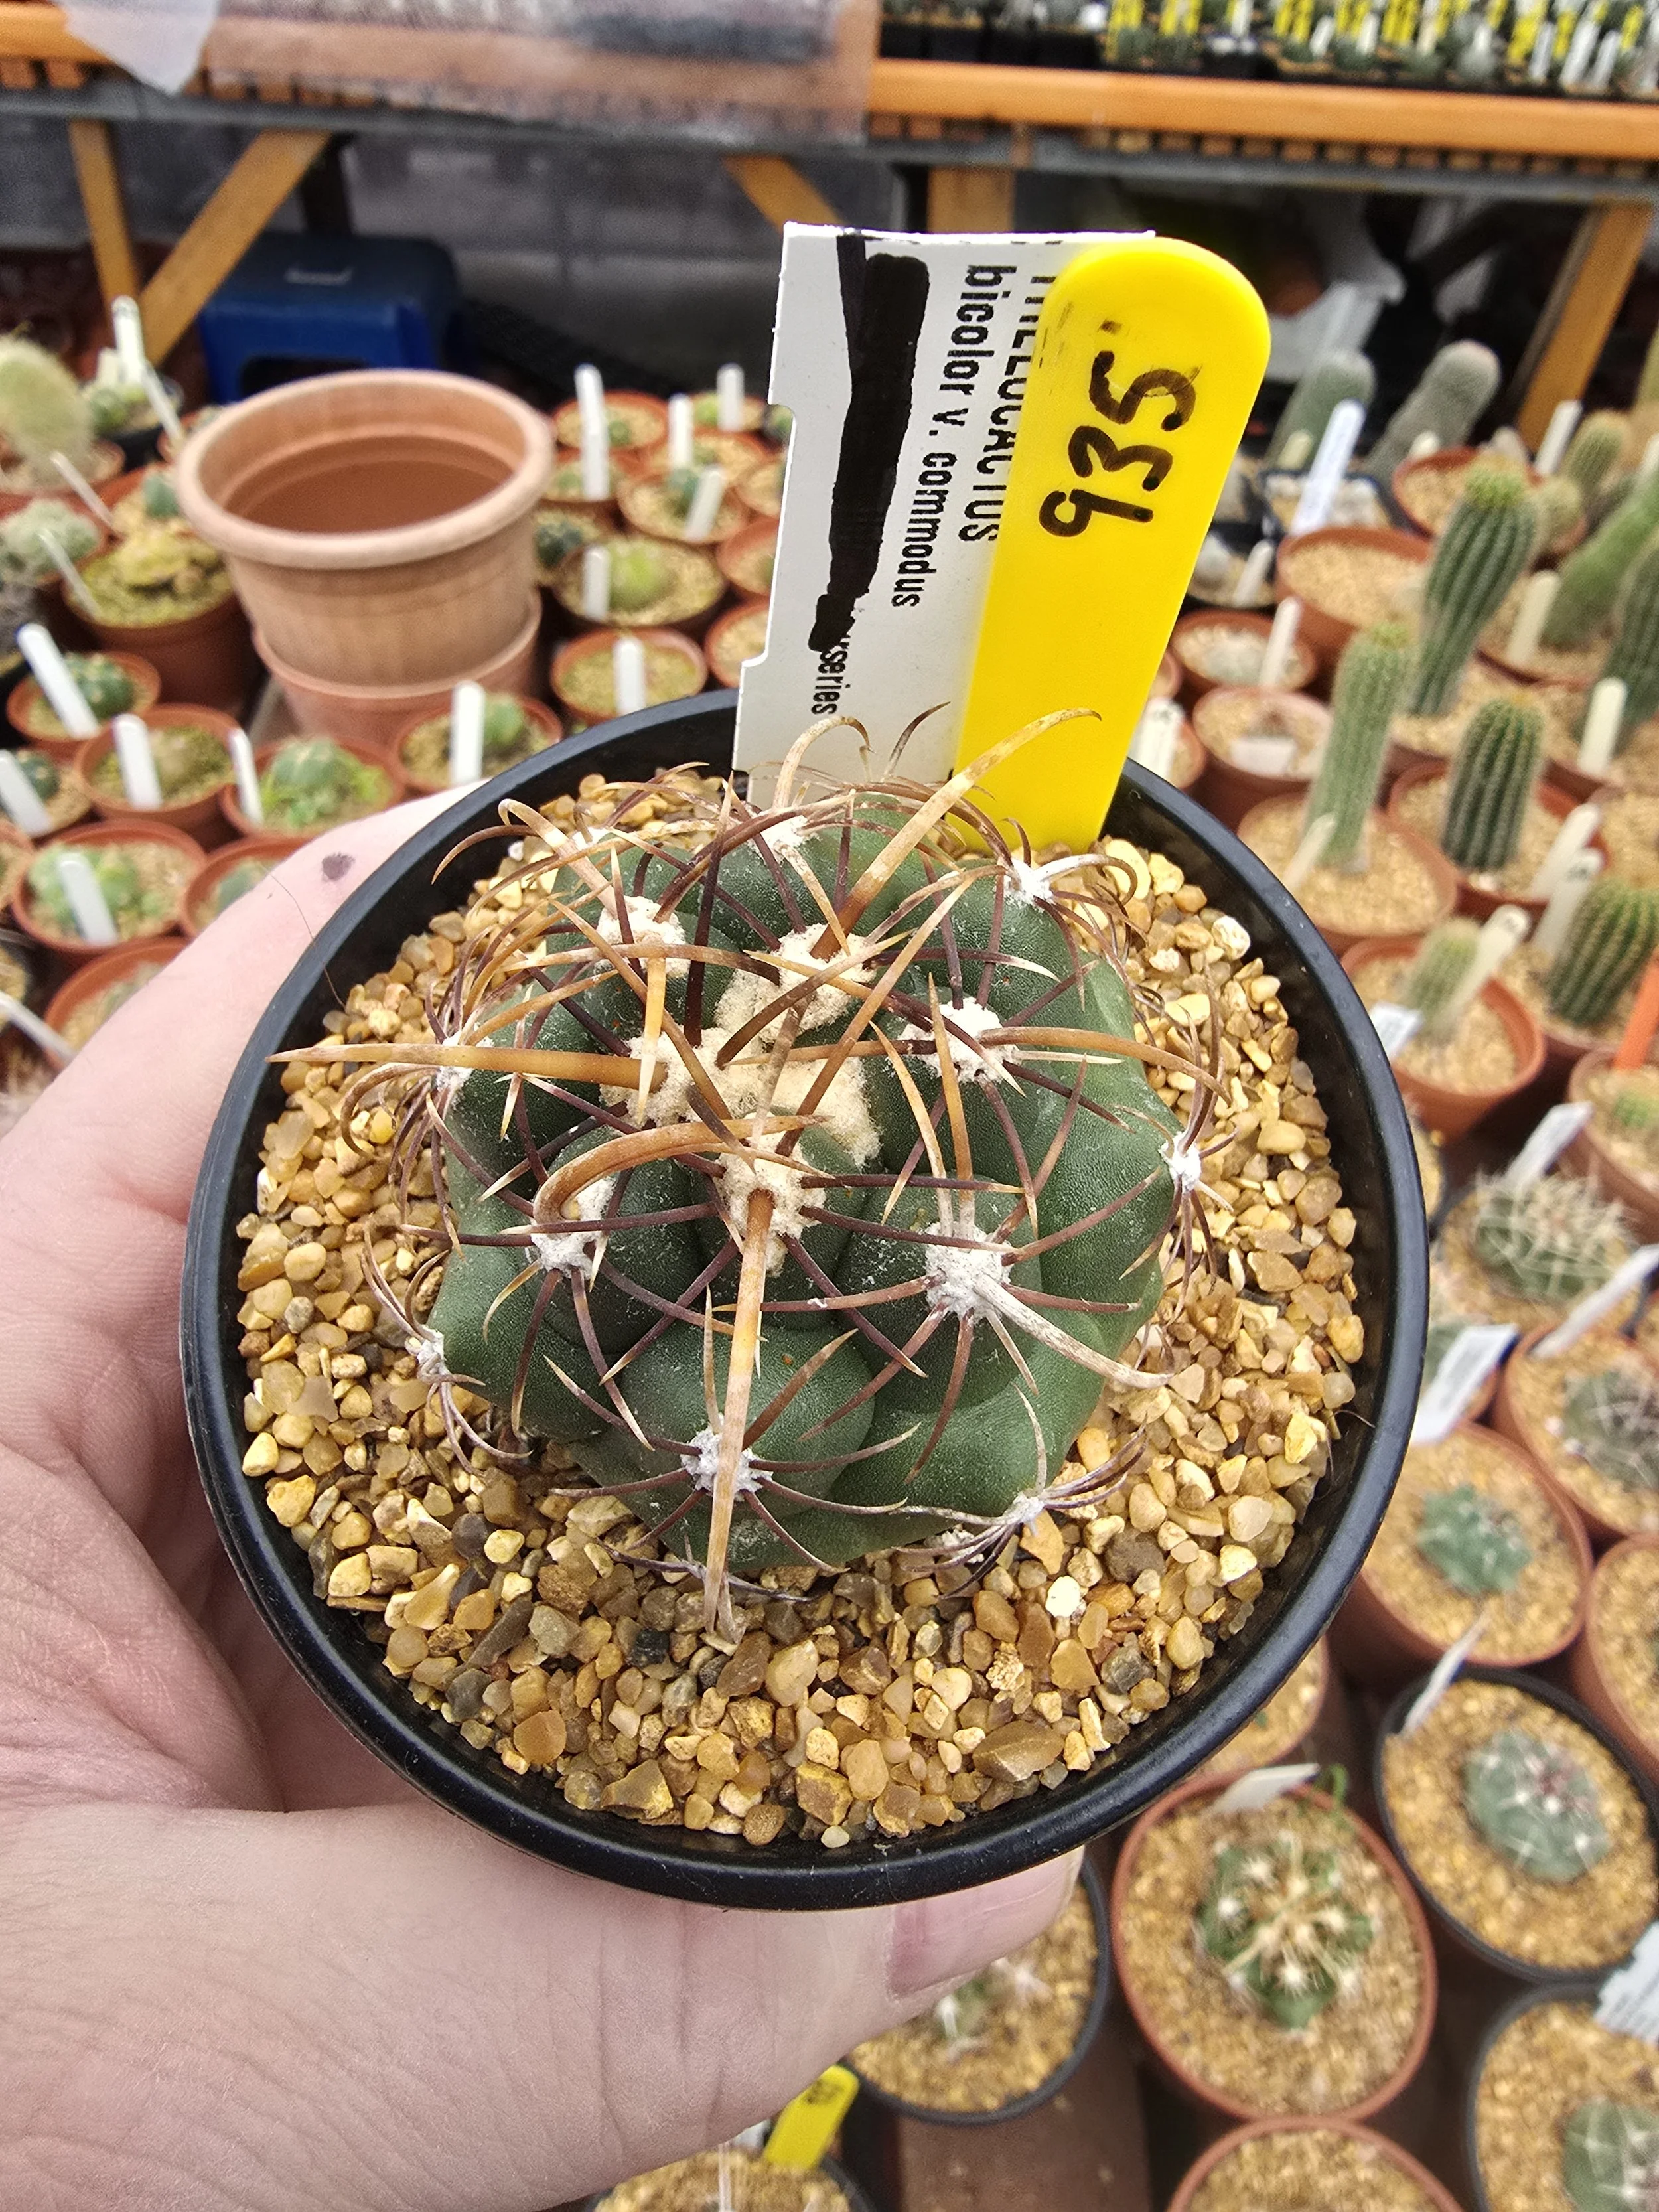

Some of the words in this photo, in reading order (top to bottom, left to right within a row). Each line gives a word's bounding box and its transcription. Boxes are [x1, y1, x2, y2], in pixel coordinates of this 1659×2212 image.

[939, 265, 1017, 396] bicolor
[928, 409, 966, 437] v.
[1039, 350, 1196, 537] 935
[891, 452, 958, 607] commodus
